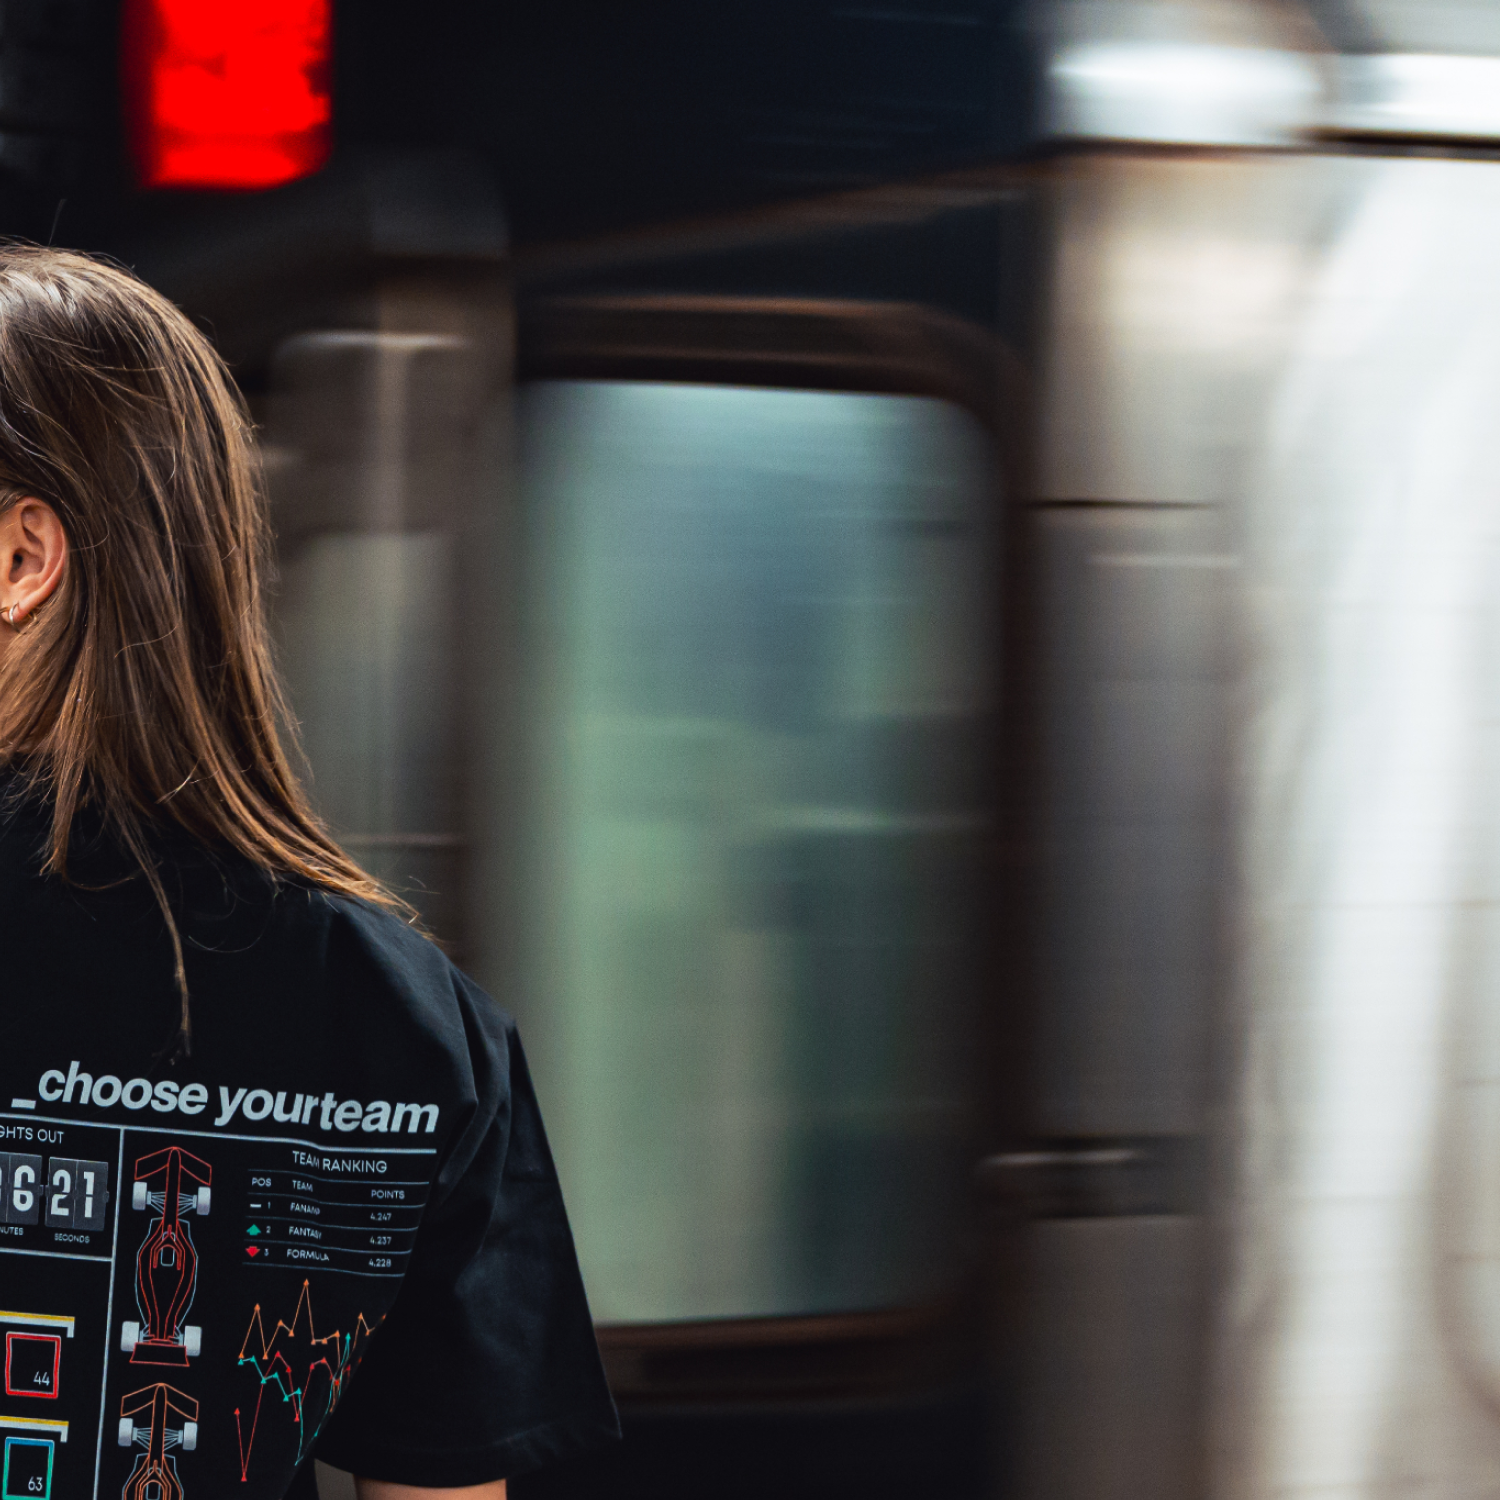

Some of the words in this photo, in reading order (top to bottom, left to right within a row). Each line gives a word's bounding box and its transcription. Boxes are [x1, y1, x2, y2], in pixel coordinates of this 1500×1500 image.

[37, 1130, 65, 1144] OUT
[292, 1150, 320, 1169] TEAM
[323, 1158, 388, 1174] RANKING
[252, 1177, 272, 1188] POS
[292, 1180, 313, 1192] TEAM
[50, 1169, 95, 1218] 21
[371, 1189, 405, 1200] POINTS
[265, 1225, 272, 1234] 2
[54, 1232, 90, 1244] SECONDS
[286, 1249, 329, 1262] FORMULA
[33, 1371, 50, 1387] 44
[28, 1476, 43, 1492] 63
